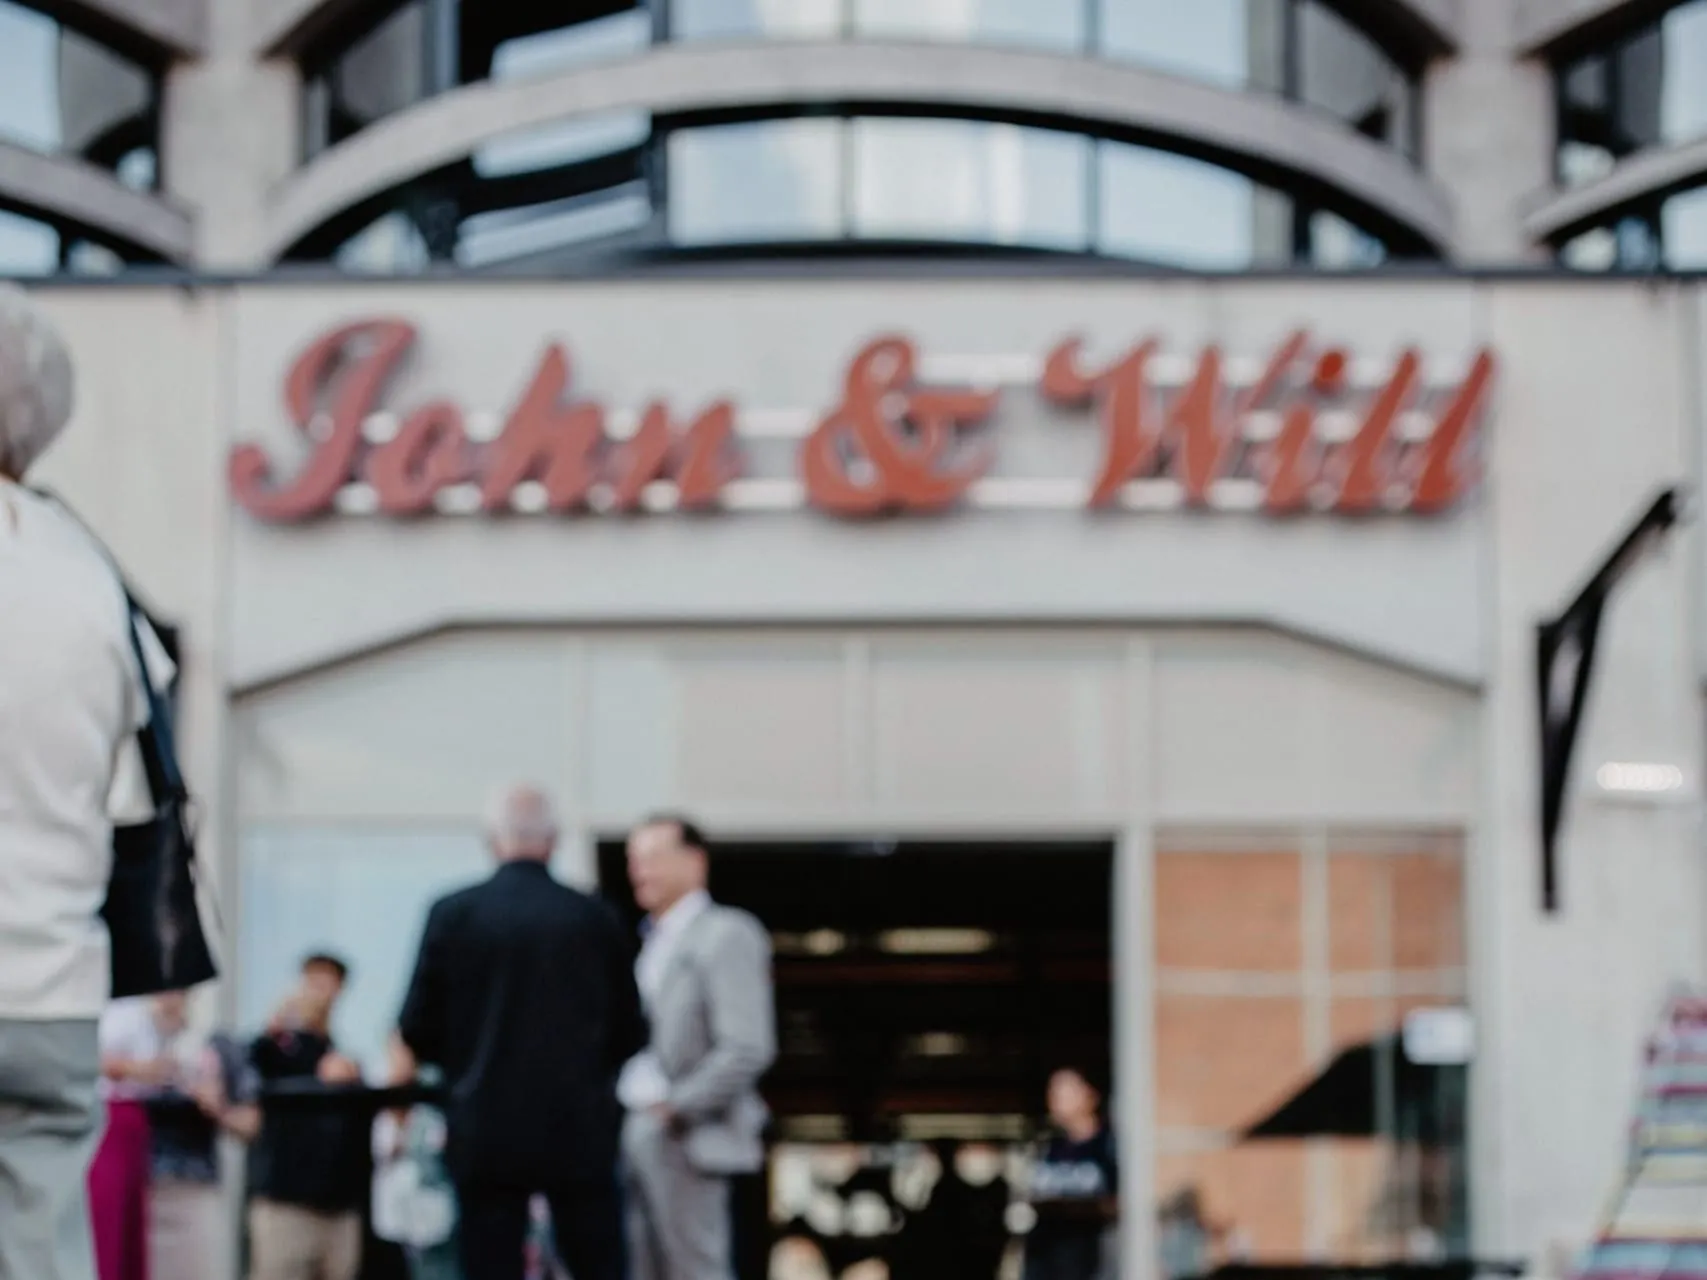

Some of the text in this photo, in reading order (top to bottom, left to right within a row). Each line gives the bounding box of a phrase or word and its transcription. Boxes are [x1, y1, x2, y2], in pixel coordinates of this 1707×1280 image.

[228, 315, 1496, 522] John & Will
